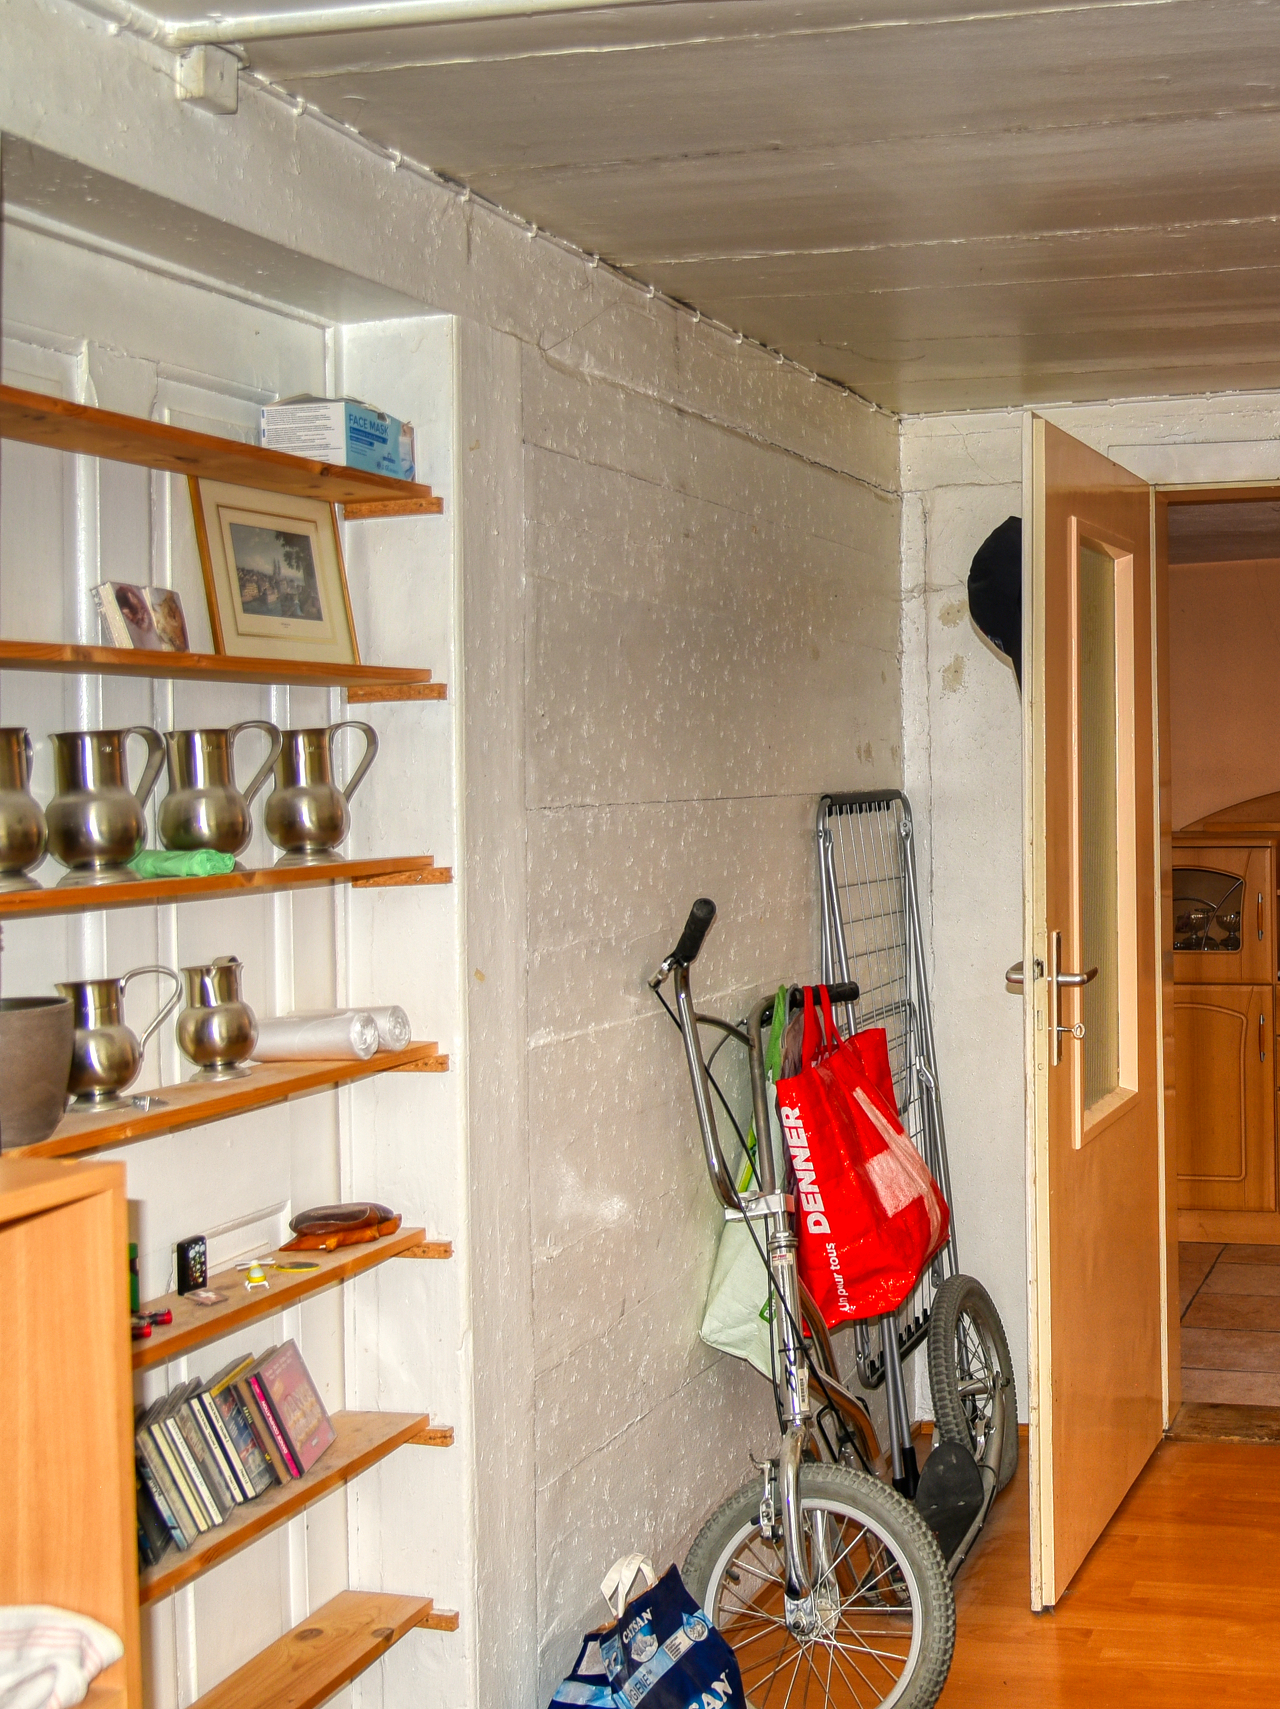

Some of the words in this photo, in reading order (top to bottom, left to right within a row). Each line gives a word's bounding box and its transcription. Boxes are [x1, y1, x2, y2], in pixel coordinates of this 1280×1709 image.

[349, 414, 368, 429] FACE
[370, 421, 388, 436] MASK
[781, 1106, 831, 1234] DENNER
[826, 1242, 840, 1270] tous
[262, 1401, 279, 1435] COMPILATION
[277, 1435, 288, 1453] DANCE
[622, 1607, 653, 1644] CATSAN
